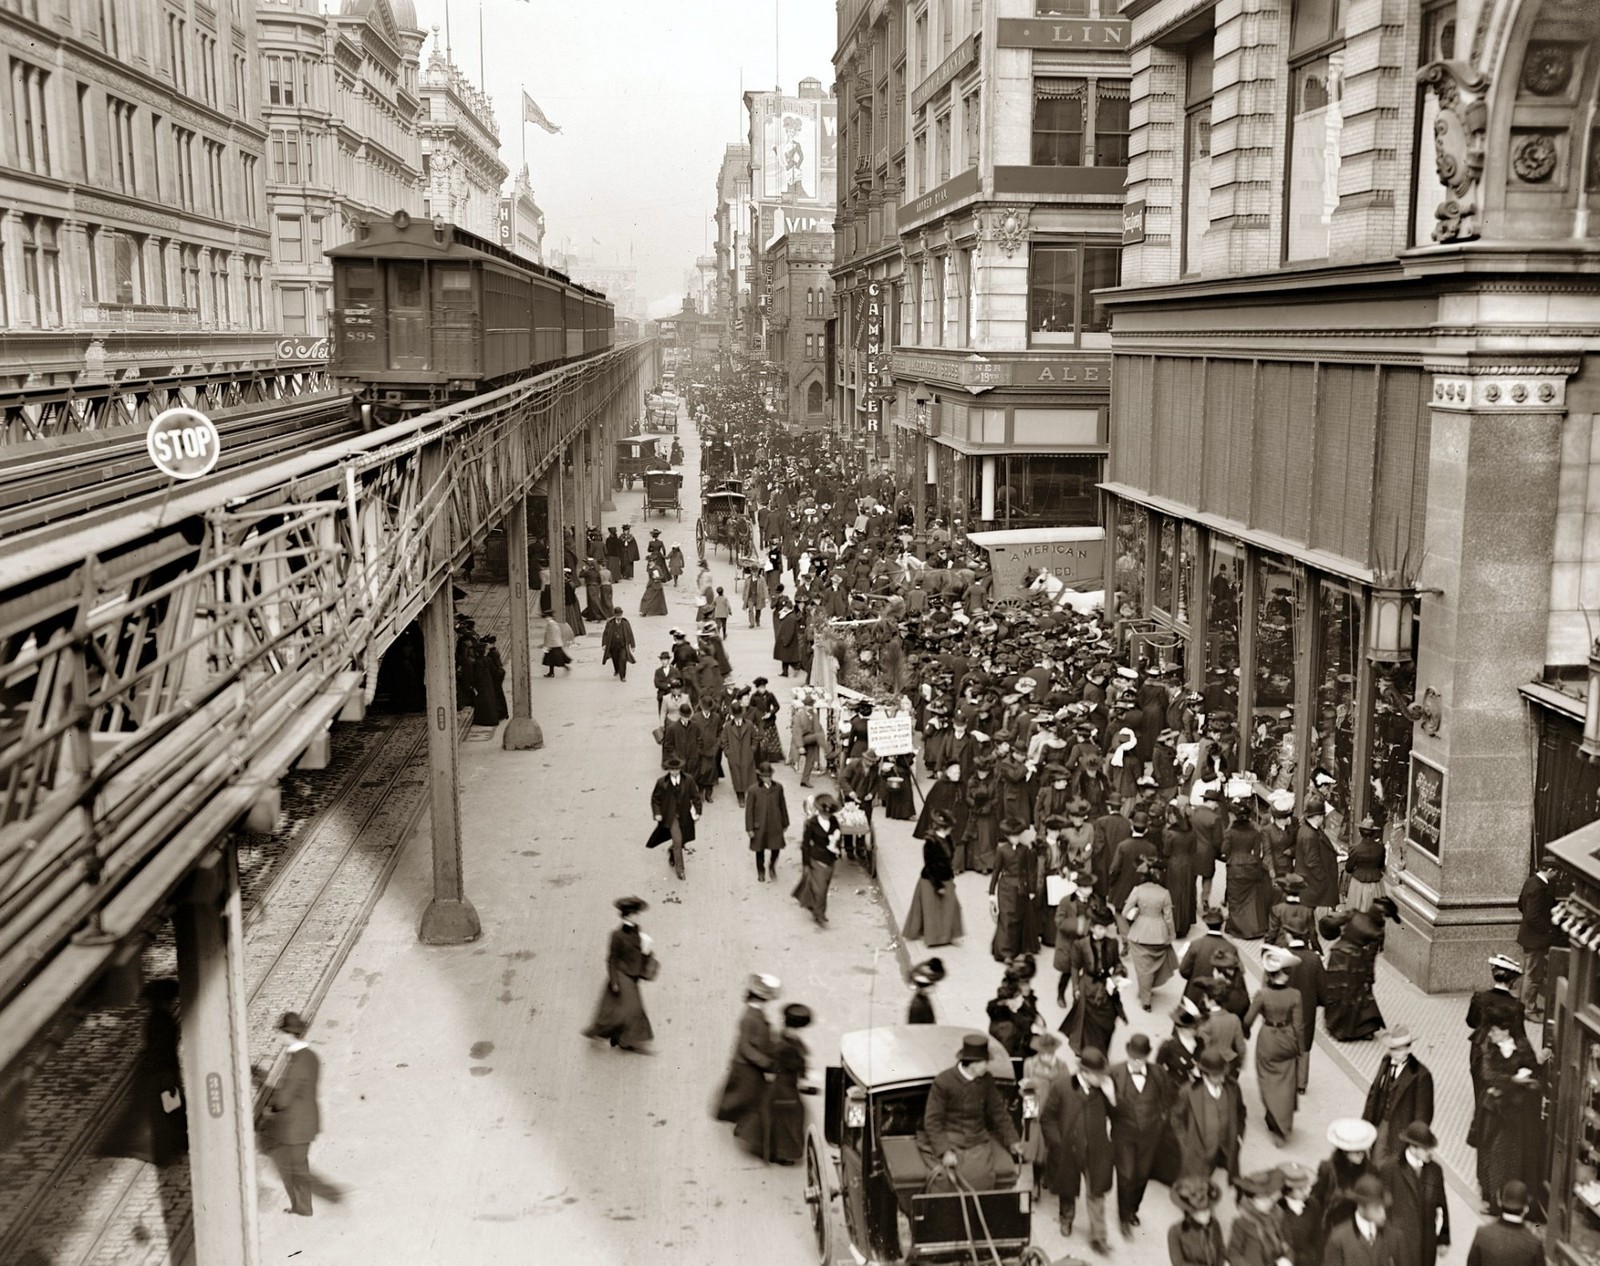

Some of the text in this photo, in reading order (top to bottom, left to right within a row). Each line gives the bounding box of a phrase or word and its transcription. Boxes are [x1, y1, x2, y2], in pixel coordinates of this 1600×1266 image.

[1052, 26, 1123, 43] LIN
[154, 426, 211, 461] STOP
[1010, 545, 1087, 562] AMERICAN
